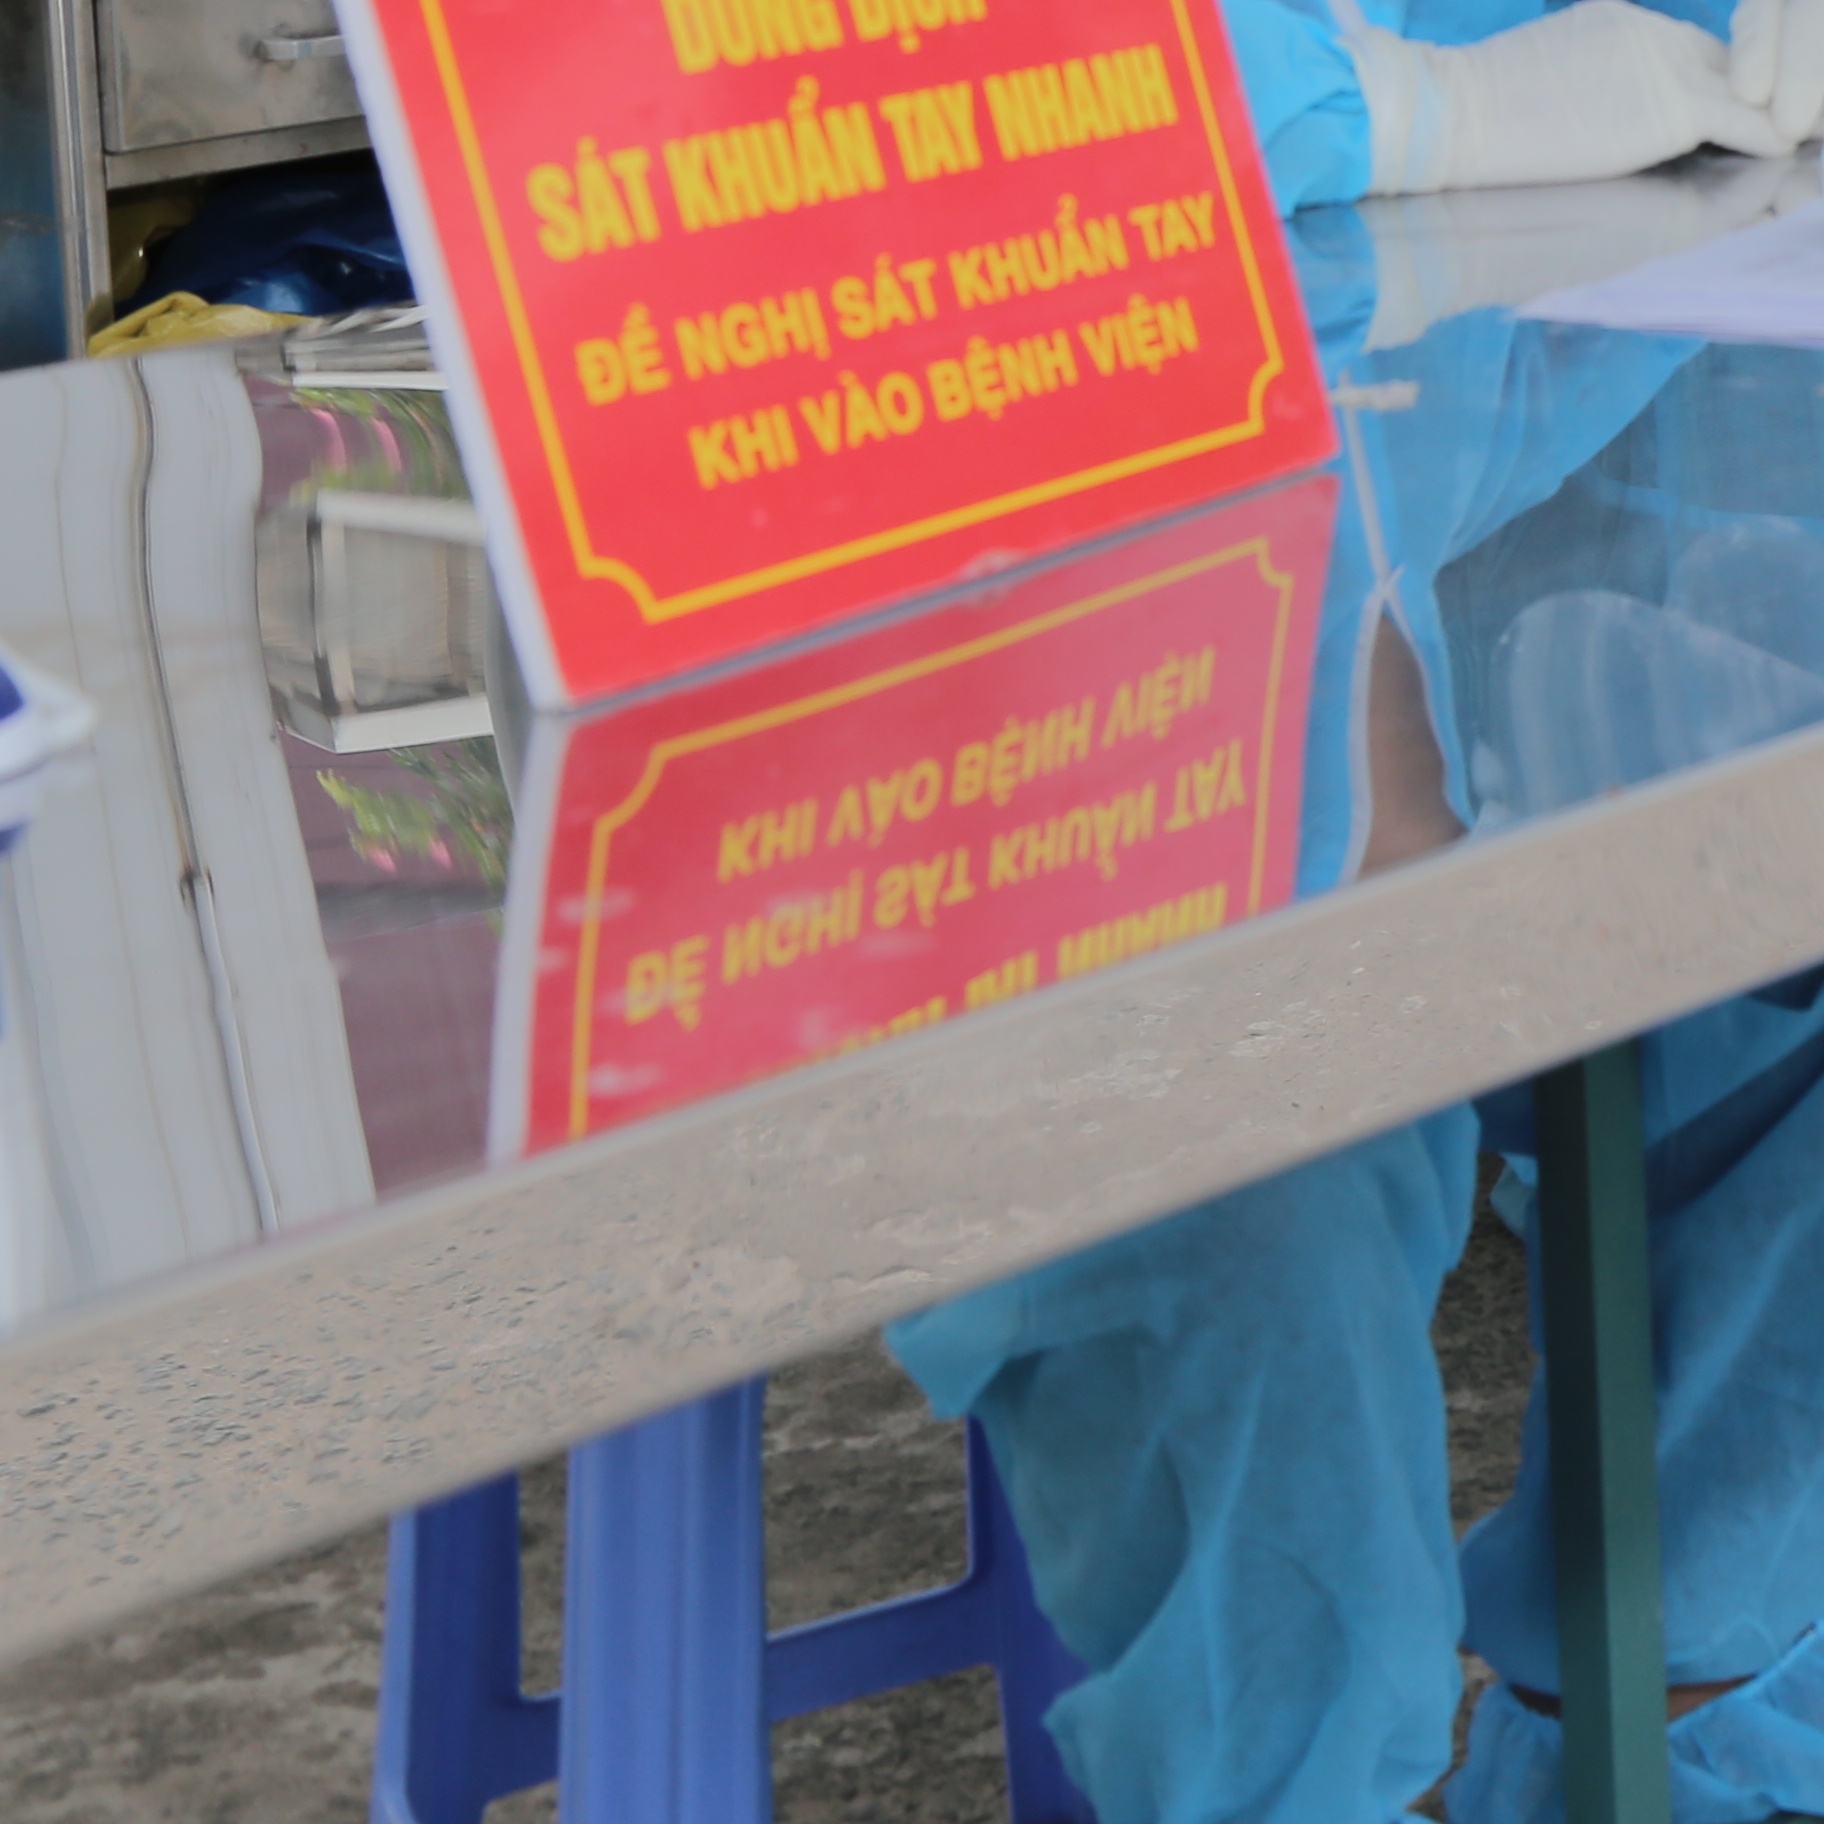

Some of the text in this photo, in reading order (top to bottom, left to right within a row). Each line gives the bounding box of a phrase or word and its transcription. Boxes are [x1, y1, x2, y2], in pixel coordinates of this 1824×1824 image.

[526, 43, 1178, 261] SÁT KHUẨN TAY NHANH
[674, 287, 831, 379] NGHỊ
[831, 252, 936, 339] SÁT
[948, 193, 1128, 309] KHUẨN
[1129, 192, 1216, 261] TAY
[688, 294, 1199, 489] KHI VÀO BỆNH VIỆN
